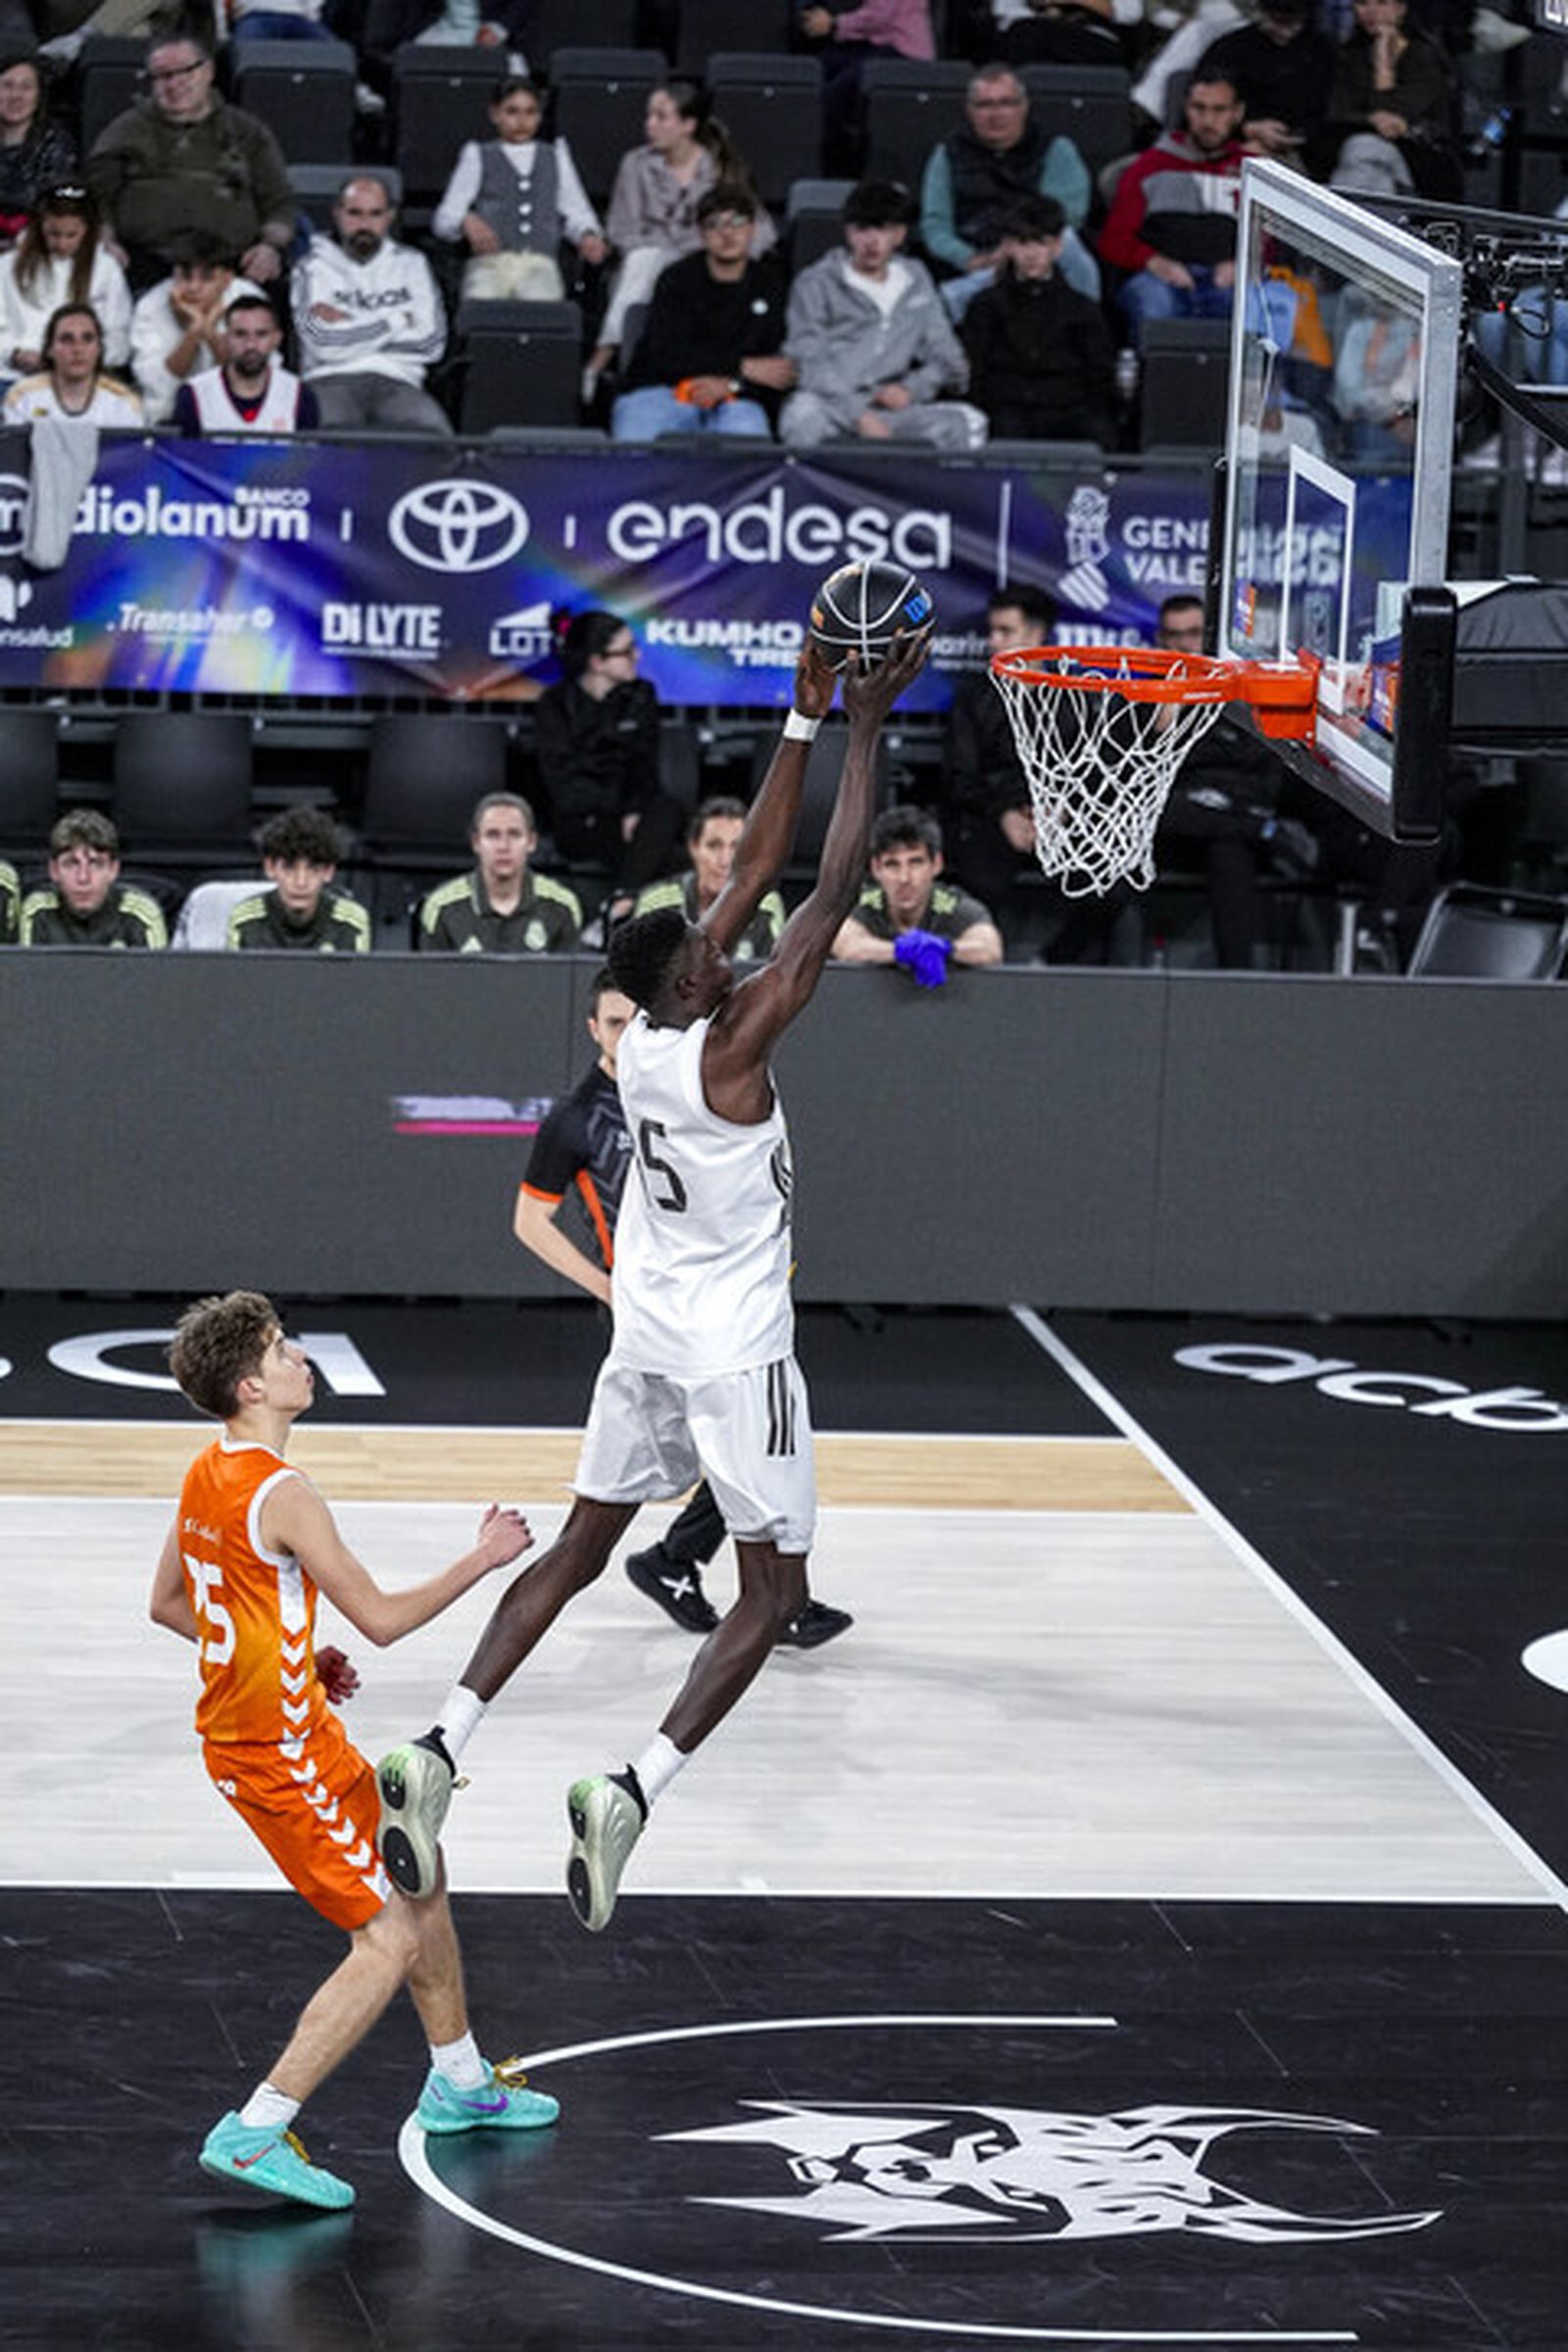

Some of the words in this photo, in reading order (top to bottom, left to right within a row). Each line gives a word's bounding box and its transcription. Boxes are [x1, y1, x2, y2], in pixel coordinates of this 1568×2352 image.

[234, 486, 311, 507] BANCO
[607, 487, 951, 568] endesa
[1123, 553, 1208, 585] VALE
[490, 628, 554, 657] LOT
[645, 619, 804, 649] KUMHO
